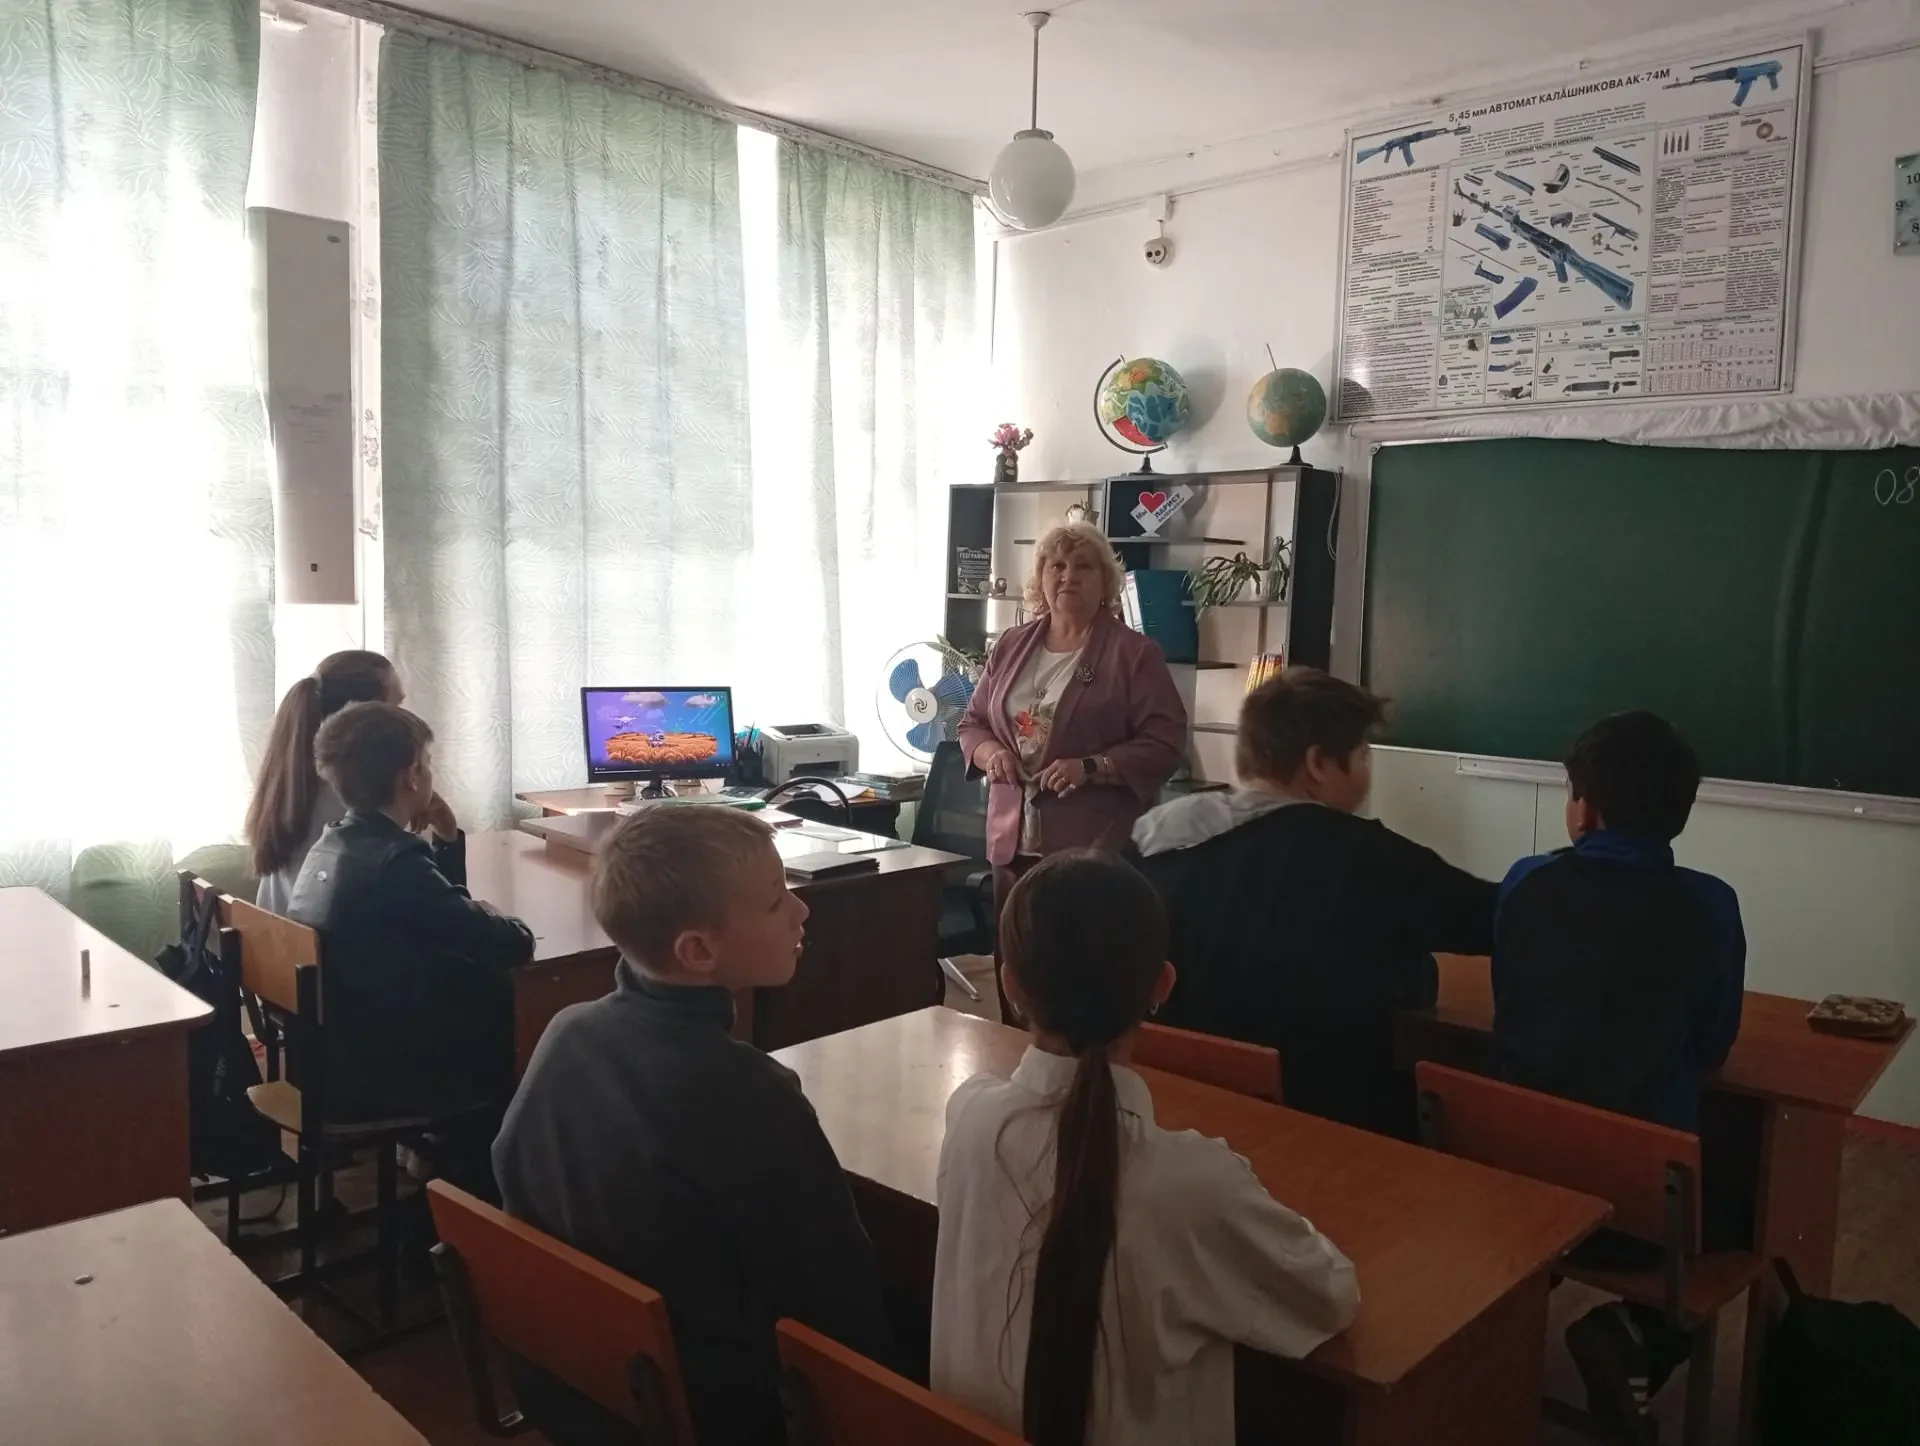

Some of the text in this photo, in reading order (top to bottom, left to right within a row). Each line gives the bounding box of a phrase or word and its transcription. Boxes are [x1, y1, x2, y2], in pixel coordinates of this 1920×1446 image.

[1448, 67, 1671, 122] 5,45 мм АВТОМАТ КАЛАШНИКОВА АК-74М
[1906, 172, 1920, 185] 10
[1911, 222, 1920, 233] 8
[1874, 465, 1920, 507] 08
[1135, 508, 1149, 520] Мы
